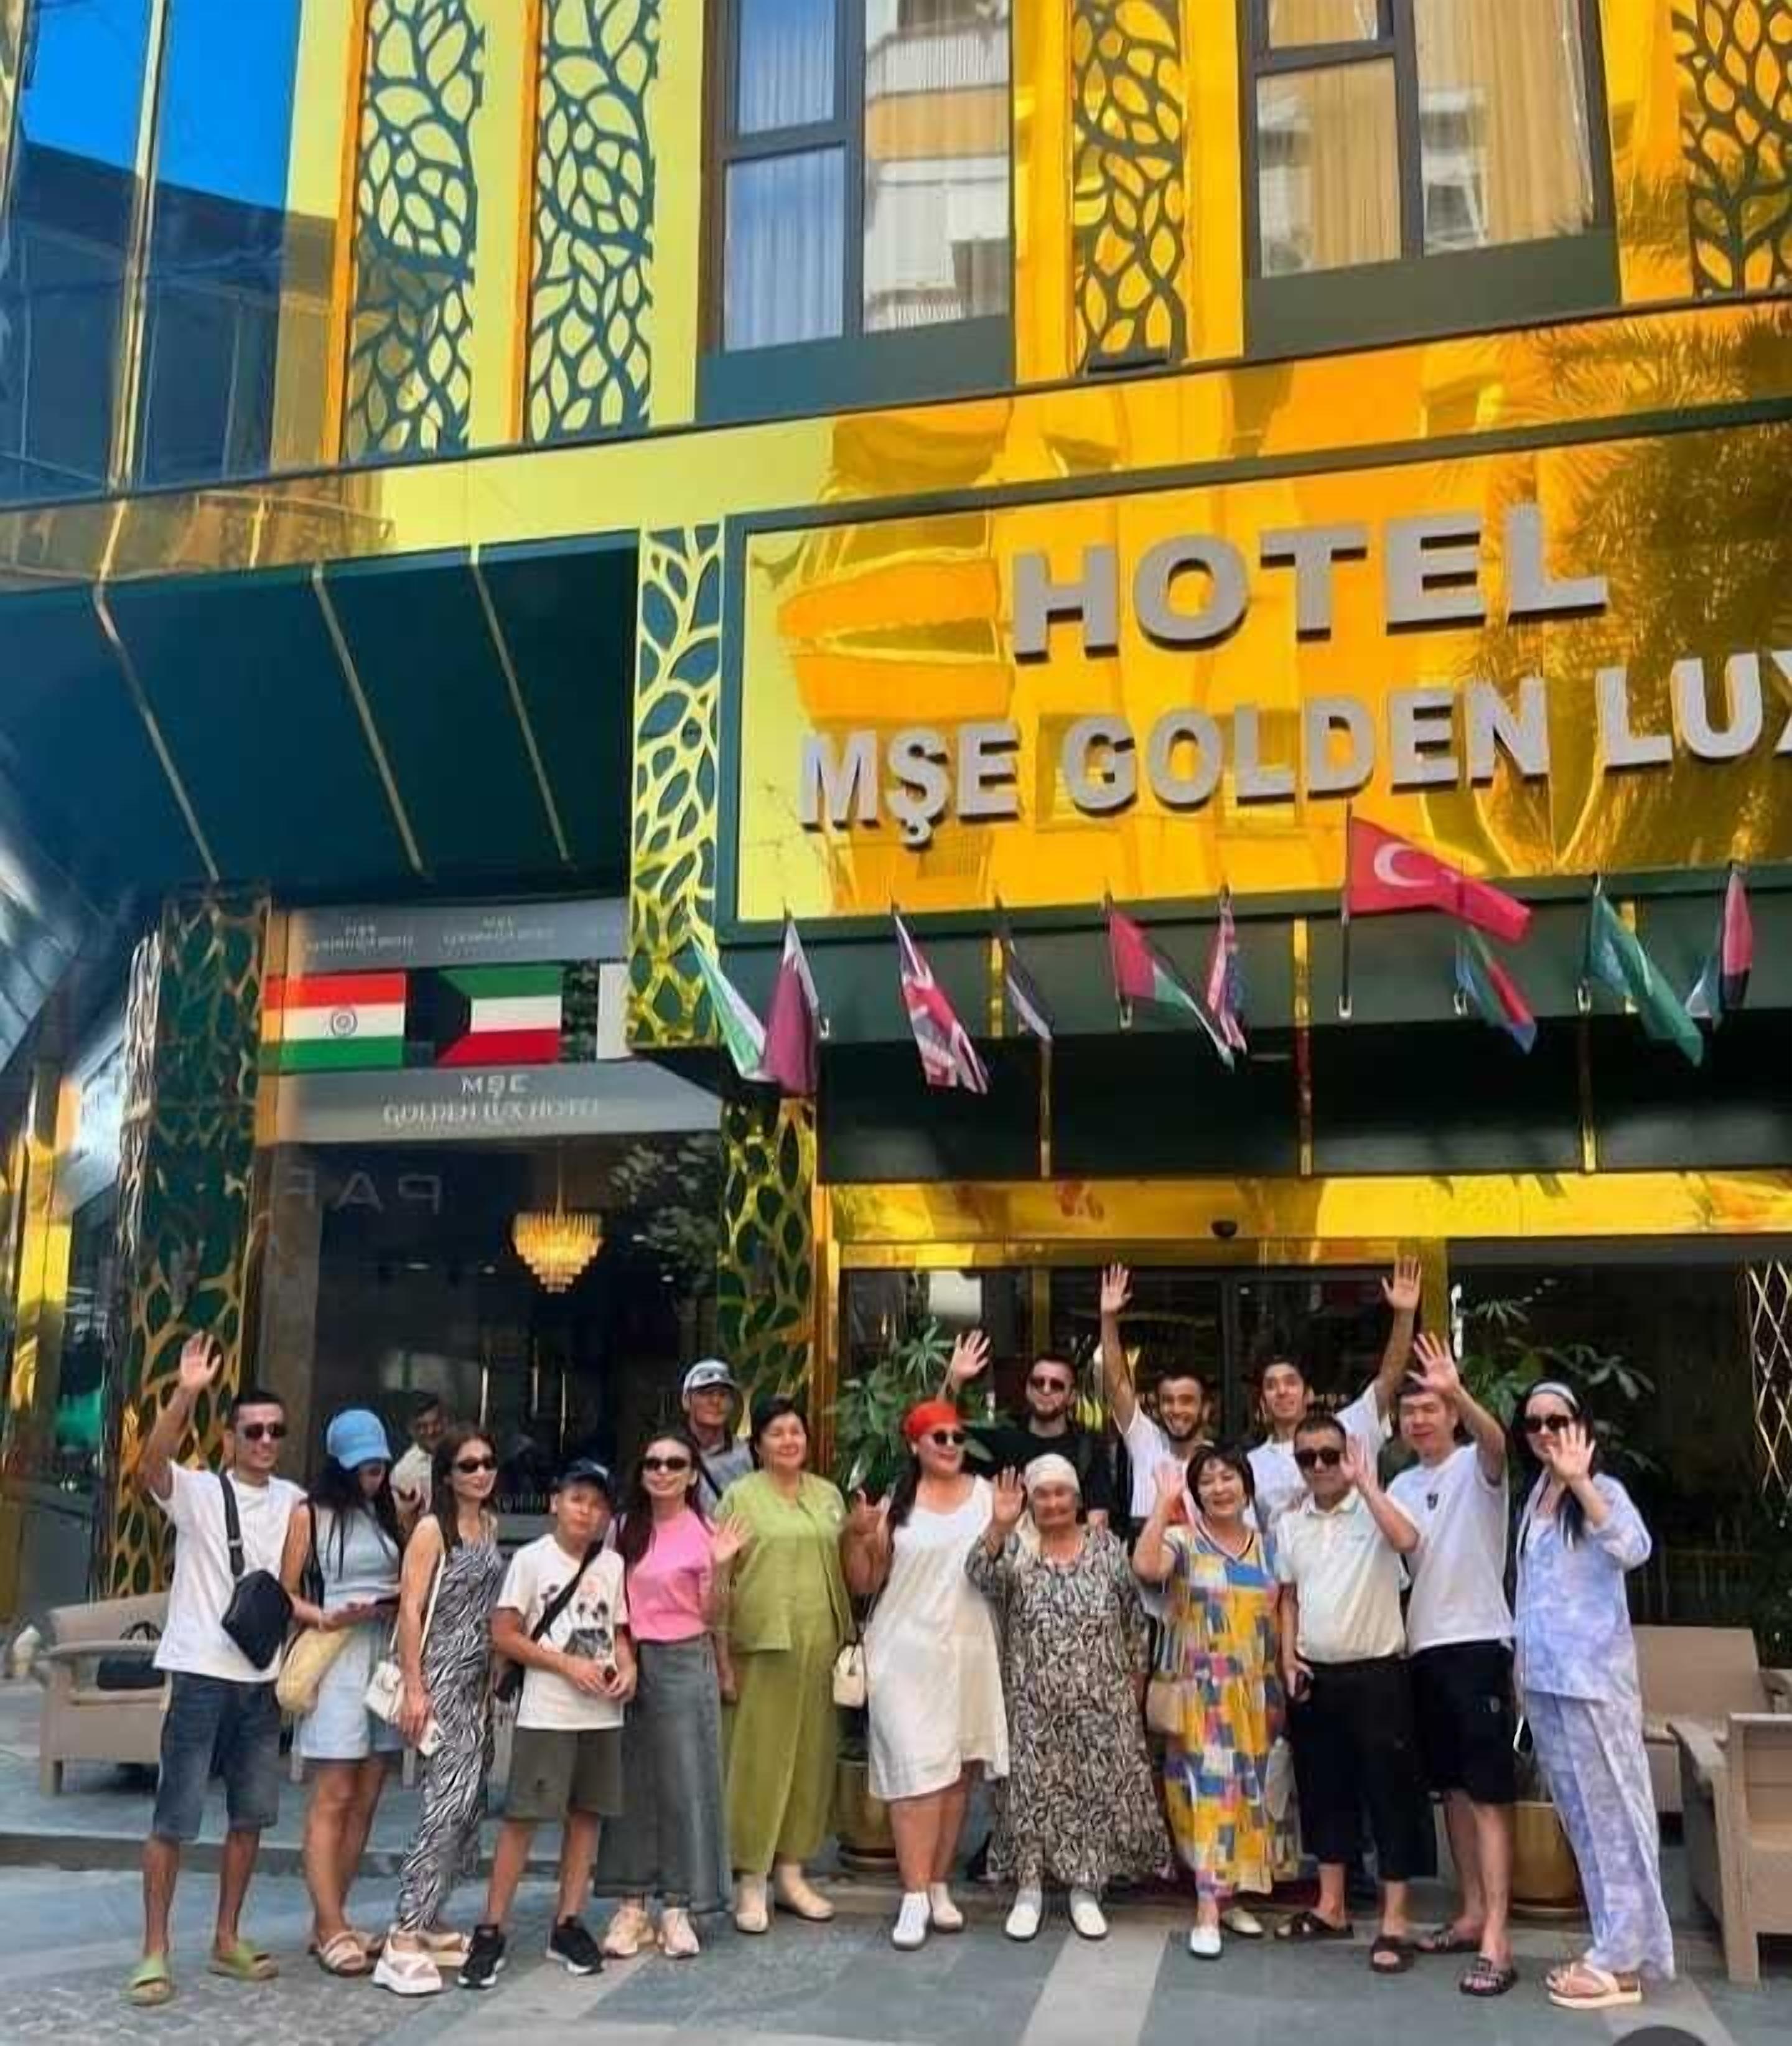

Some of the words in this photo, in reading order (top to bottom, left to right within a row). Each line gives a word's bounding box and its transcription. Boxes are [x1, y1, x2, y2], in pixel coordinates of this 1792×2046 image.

[1012, 503, 1607, 665] HOTEL
[798, 722, 1019, 851] MŞE
[1063, 677, 1549, 817] GOLDEN
[1595, 650, 1792, 773] LU
